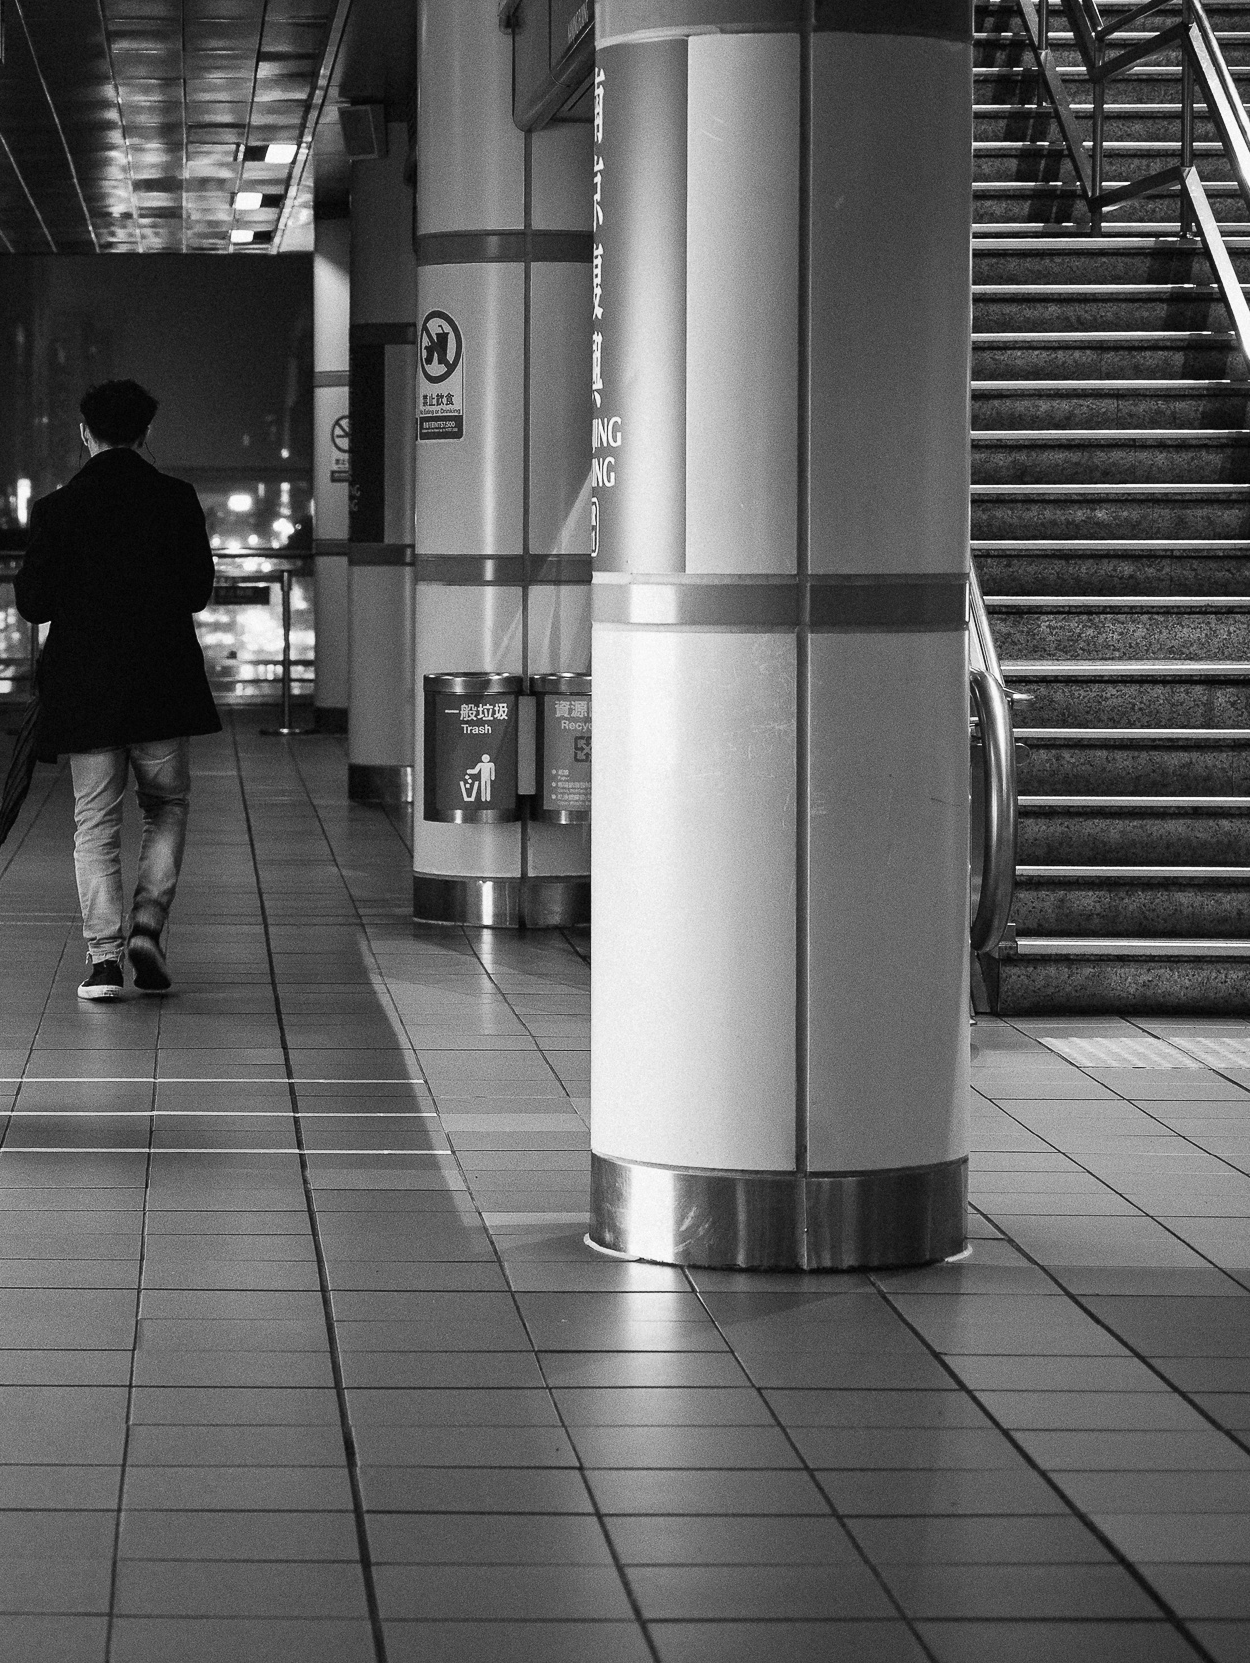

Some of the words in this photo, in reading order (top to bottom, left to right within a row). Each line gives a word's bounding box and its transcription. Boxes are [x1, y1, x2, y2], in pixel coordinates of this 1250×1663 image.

[444, 703, 509, 721] 一般垃圾
[554, 700, 592, 718] 資源
[461, 724, 492, 734] Trash
